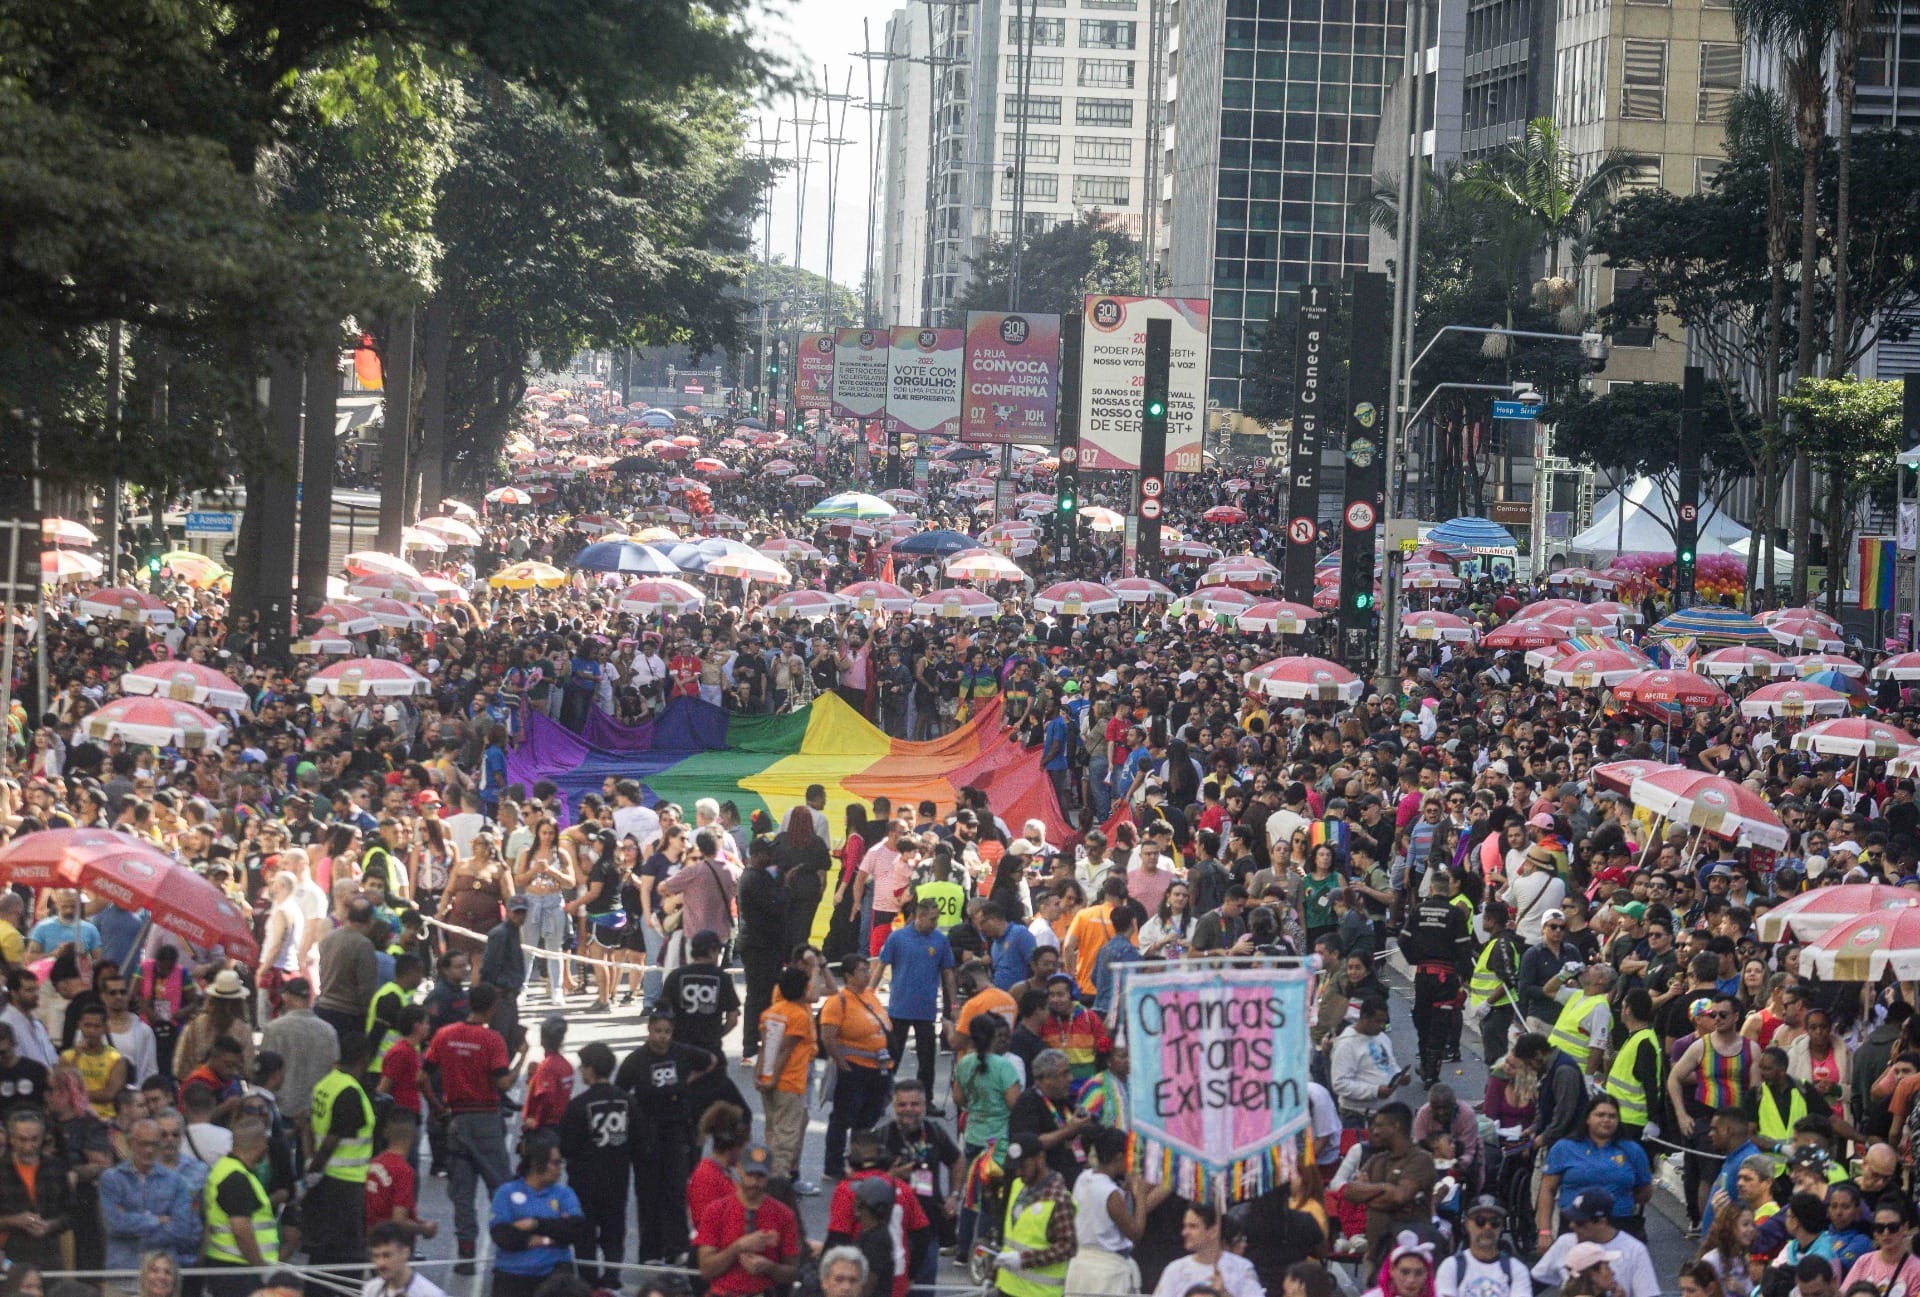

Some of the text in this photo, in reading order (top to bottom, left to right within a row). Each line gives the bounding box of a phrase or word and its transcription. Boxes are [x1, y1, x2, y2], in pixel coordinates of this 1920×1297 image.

[1098, 303, 1112, 317] 30
[1004, 320, 1020, 335] 30
[973, 349, 1007, 359] A RUA
[1093, 345, 1196, 358] PODER PA GBTI+
[972, 358, 1049, 374] CONVOCA
[1093, 358, 1121, 366] NOSSO
[895, 365, 957, 377] VOTE COM
[893, 376, 956, 388] ORGULHO:
[1008, 375, 1049, 385] A URNA
[971, 383, 1048, 398] CONFIRMA
[1129, 389, 1141, 397] DE
[893, 393, 956, 402] QUE REPRESENTA
[1091, 397, 1131, 407] NOSSAS
[971, 407, 986, 419] 07
[1091, 407, 1133, 418] NOSSO
[1297, 331, 1320, 487] R. Frei Caneca
[1496, 407, 1514, 415] Hosp
[1024, 409, 1044, 422] 10H
[887, 420, 898, 429] 07
[944, 422, 960, 432] 10H
[1090, 419, 1111, 431] DE
[1114, 420, 1143, 433] SER
[1081, 448, 1099, 463] 07
[1175, 452, 1200, 467] 10H
[1145, 482, 1159, 491] 50
[11, 866, 51, 878] AMSTEL
[95, 876, 134, 903] AMSTEL
[1138, 993, 1286, 1036] Crianças
[1166, 1034, 1274, 1075] Trans
[1154, 1072, 1300, 1118] Existem
